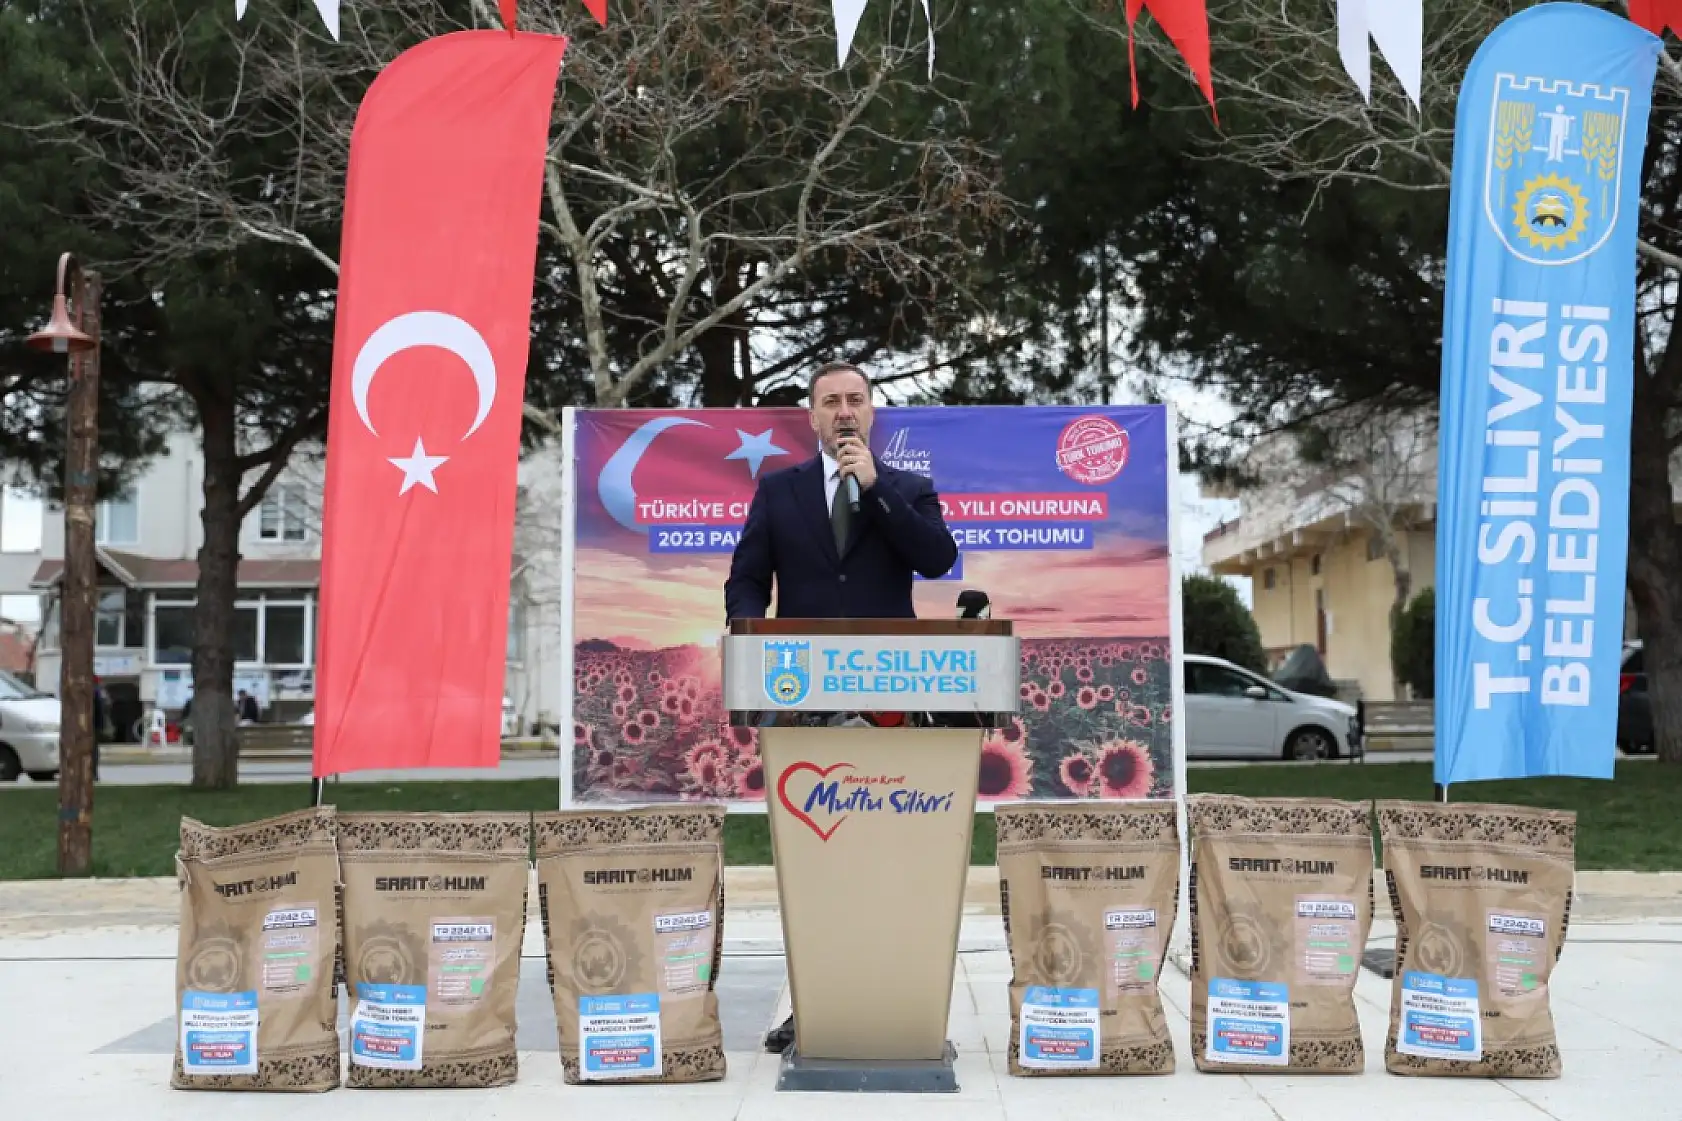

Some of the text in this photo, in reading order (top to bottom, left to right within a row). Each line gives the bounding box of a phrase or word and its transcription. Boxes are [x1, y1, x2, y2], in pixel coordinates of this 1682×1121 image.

[639, 499, 725, 519] TÜRKİYE
[959, 501, 995, 516] YILI
[1000, 500, 1103, 516] ONURUNA
[1540, 303, 1611, 707] BELEDİYESİ
[658, 532, 705, 548] 2023
[995, 528, 1084, 545] TOHUMU
[823, 675, 977, 693] BELEDİYESİ
